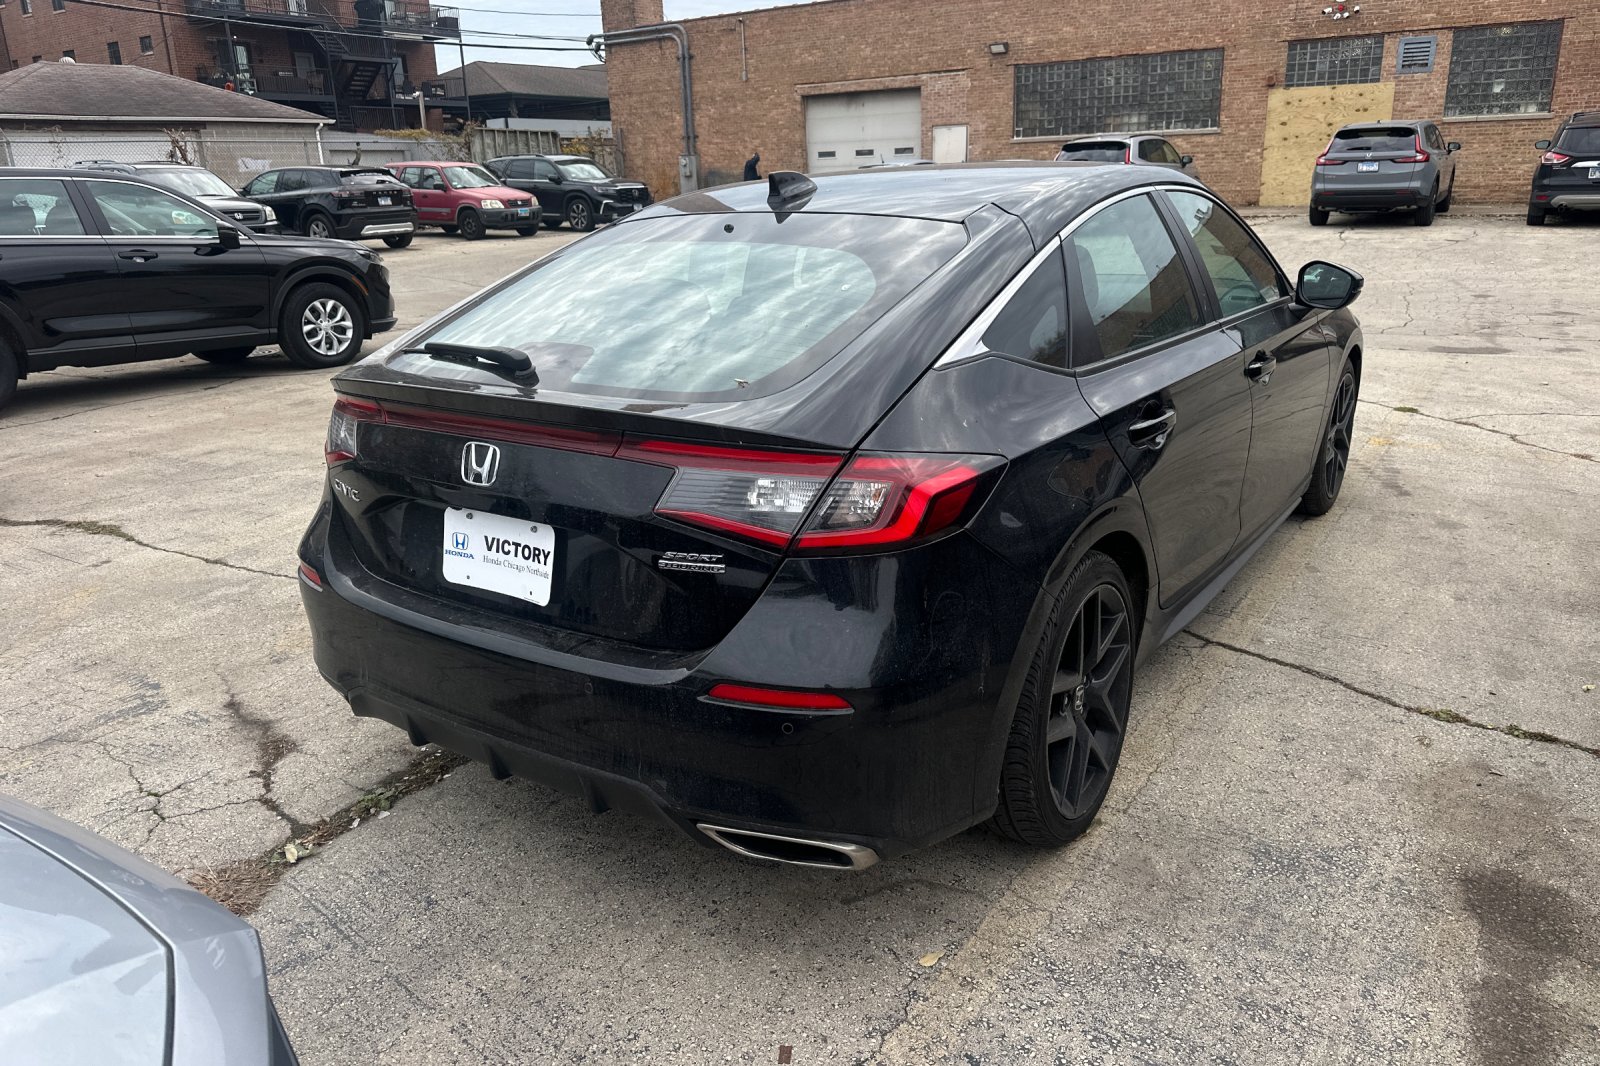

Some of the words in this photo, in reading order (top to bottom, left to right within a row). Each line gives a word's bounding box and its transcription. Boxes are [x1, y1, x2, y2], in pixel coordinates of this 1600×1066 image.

[445, 549, 474, 560] HONDA
[484, 535, 551, 566] VICTORY
[662, 551, 724, 562] SPORT
[482, 555, 502, 566] Honda
[503, 559, 526, 573] Chicago
